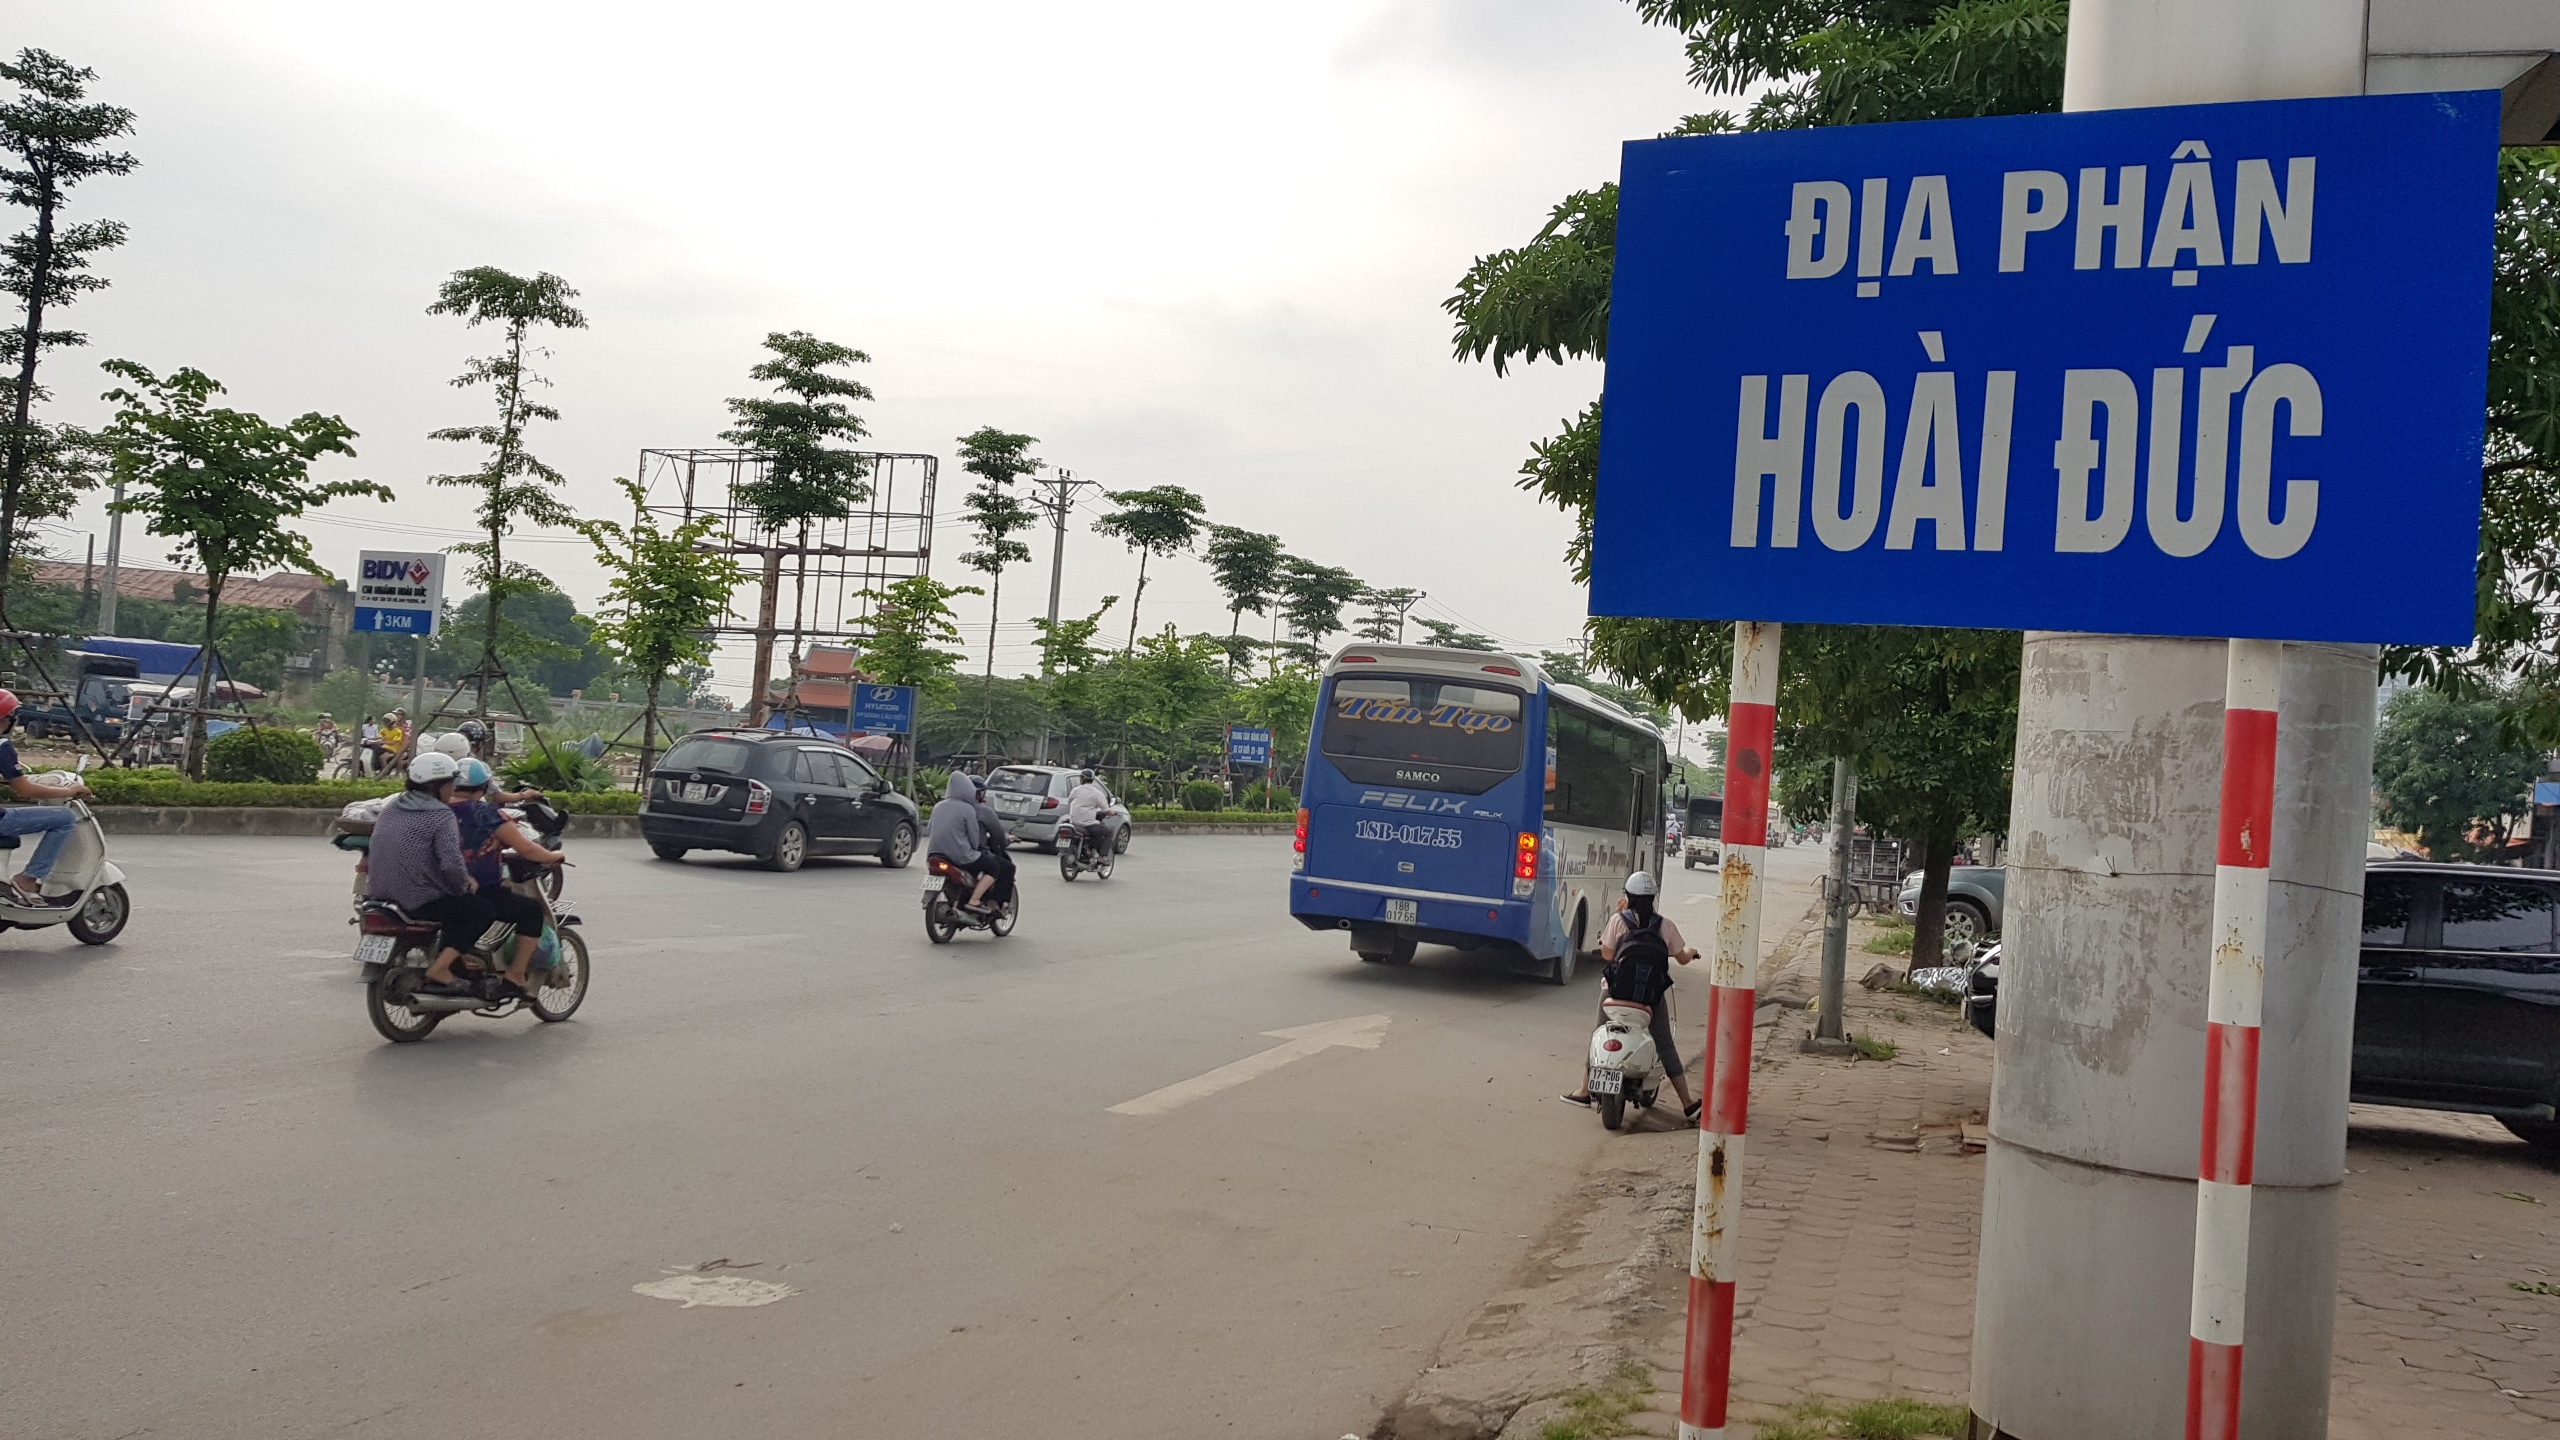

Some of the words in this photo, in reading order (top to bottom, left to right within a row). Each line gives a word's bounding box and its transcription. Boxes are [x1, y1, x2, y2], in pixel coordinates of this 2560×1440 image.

[1784, 175, 1959, 298] ĐỊA
[1998, 140, 2317, 287] PHẬN
[1729, 331, 2016, 552] HOÀI
[2053, 314, 2324, 560] ĐỨC
[362, 560, 410, 580] BIDV
[384, 615, 412, 628] 3KM
[864, 703, 900, 711] HYUNDAI
[1428, 703, 1512, 735] Tạo
[1396, 769, 1440, 782] SAMCO
[1359, 790, 1468, 814] FELIX
[1355, 819, 1462, 848] 18B-017.55
[1394, 900, 1410, 912] 18B
[1589, 1080, 1619, 1092] 001.76
